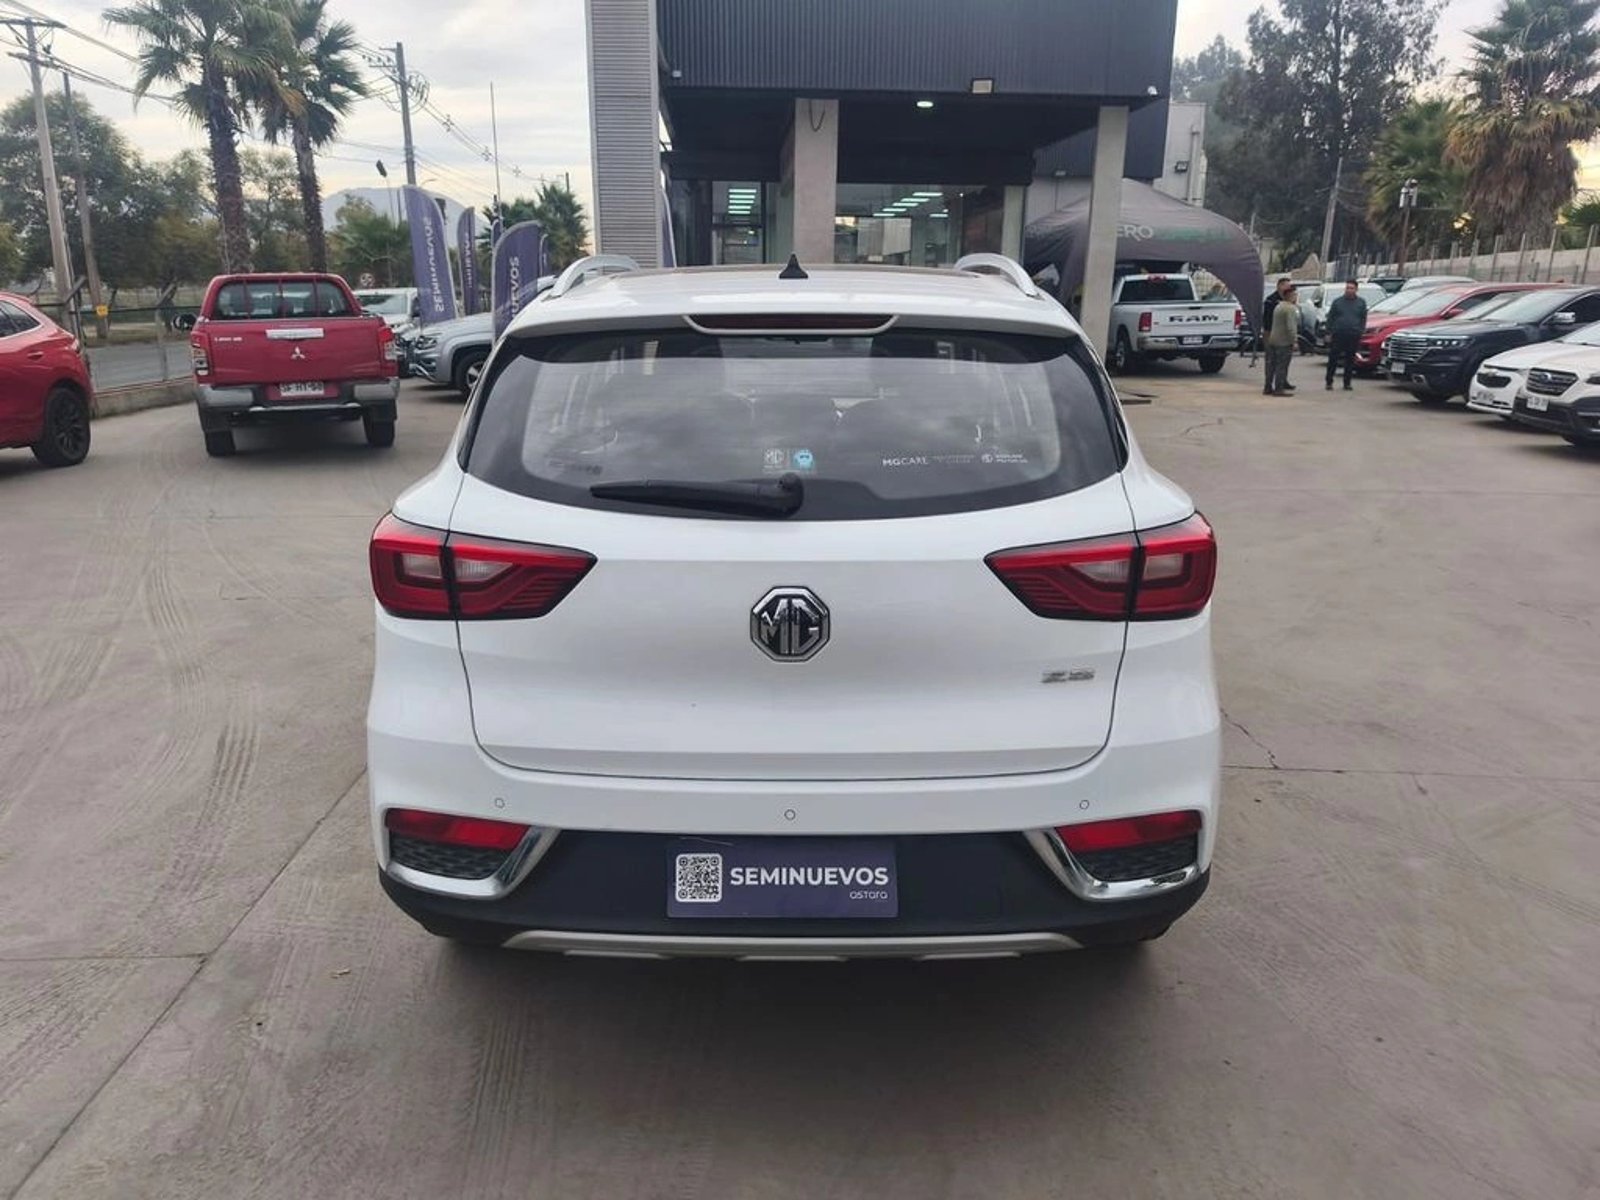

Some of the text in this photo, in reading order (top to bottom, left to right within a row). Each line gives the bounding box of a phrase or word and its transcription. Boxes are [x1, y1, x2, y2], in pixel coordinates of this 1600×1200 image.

[1168, 315, 1219, 323] RAM
[758, 596, 822, 656] MG
[729, 867, 889, 886] SEMINUEVOS
